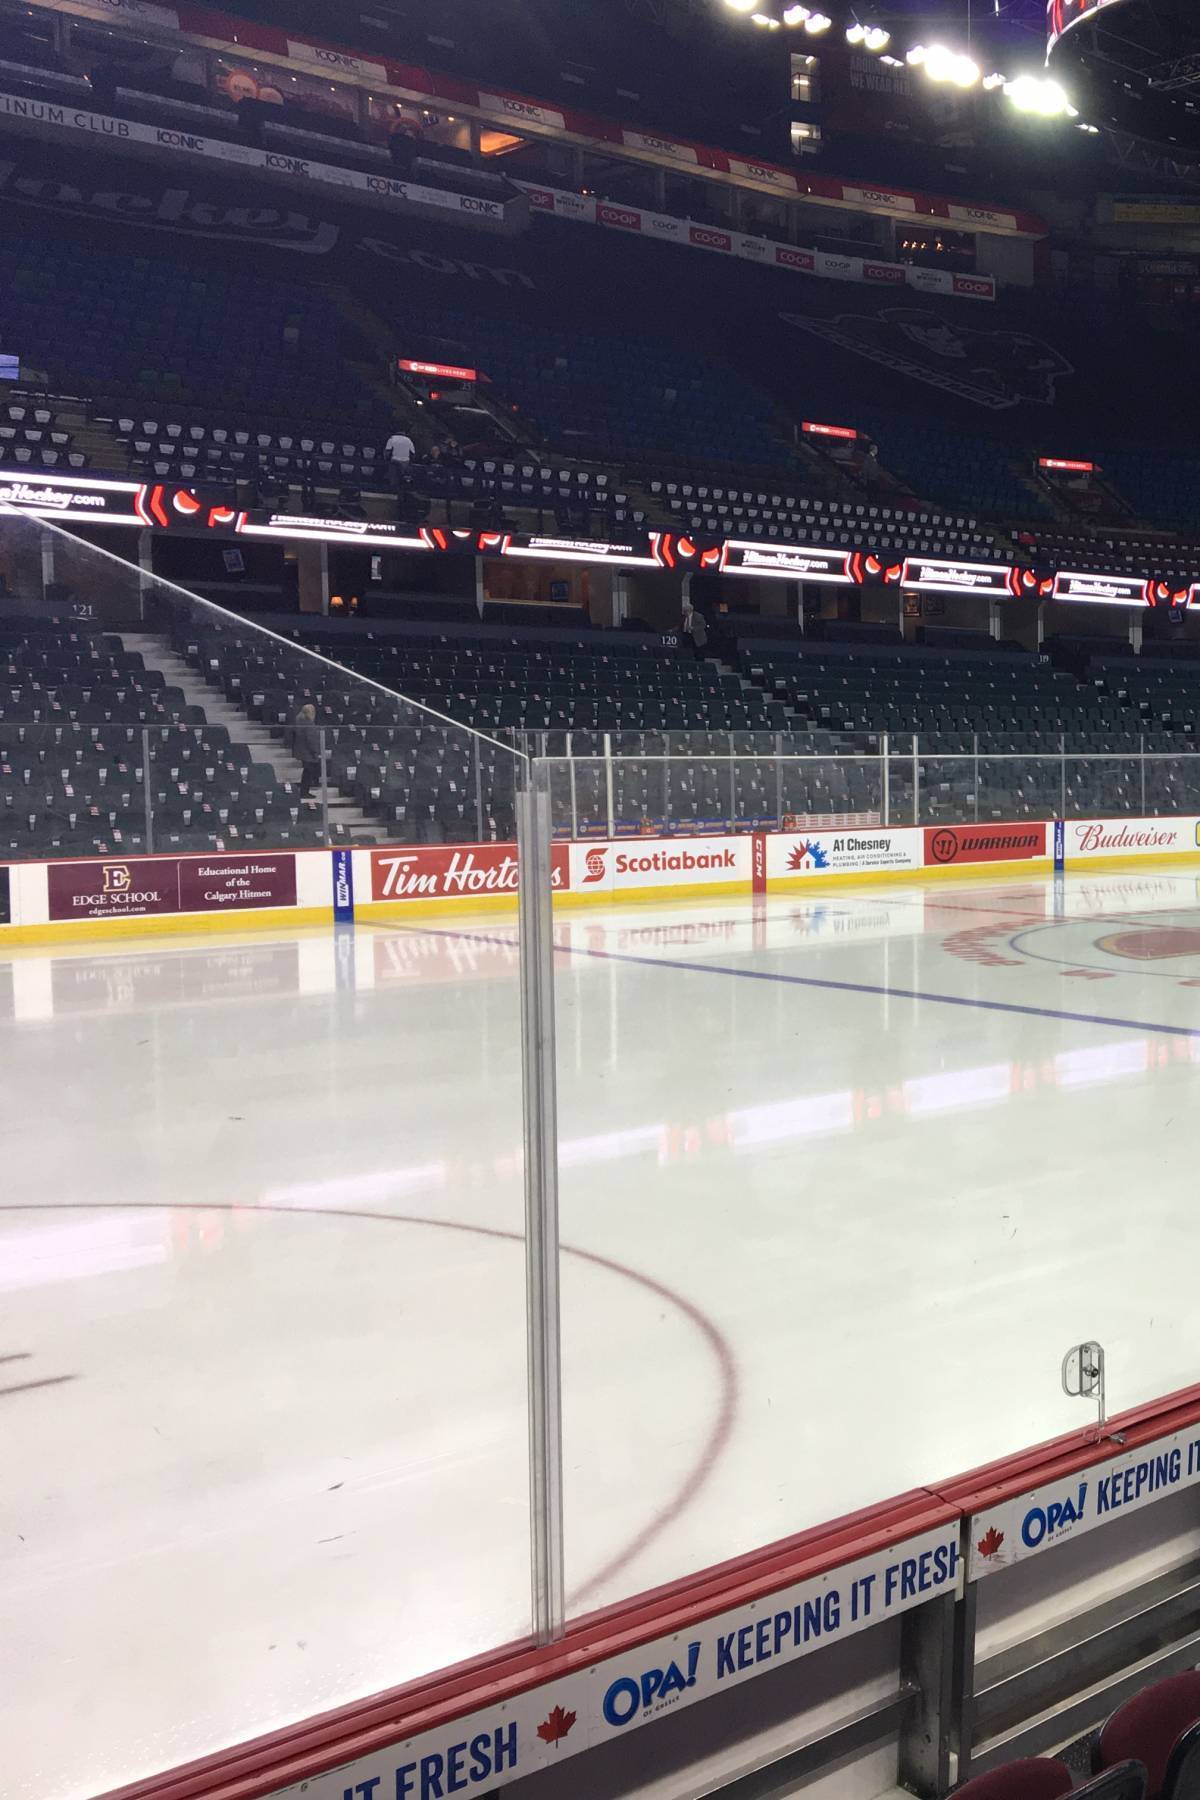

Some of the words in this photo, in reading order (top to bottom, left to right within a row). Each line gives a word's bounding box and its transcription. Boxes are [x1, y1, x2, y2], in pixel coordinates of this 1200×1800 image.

[74, 113, 131, 138] CLUB
[156, 130, 204, 151] ICONIC
[265, 154, 310, 175] ICONIC
[366, 176, 408, 197] ICONIC
[460, 197, 499, 217] ICONIC
[73, 604, 93, 616] 121
[661, 635, 678, 645] 120
[833, 840, 844, 852] A1
[847, 837, 891, 852] Chesney
[960, 835, 1037, 851] WARRIOR
[1075, 824, 1177, 851] Budweiser
[198, 865, 249, 878] Educational
[250, 863, 276, 875] Home
[616, 849, 737, 875] Scotiabank
[226, 877, 235, 887] of
[236, 877, 250, 887] the
[378, 855, 436, 897] Tim
[443, 852, 562, 893] Hortos
[72, 892, 108, 907] EDGE
[111, 891, 161, 905] SCHOOL
[204, 889, 238, 902] Calgary
[239, 888, 272, 900] Hitmen
[89, 905, 146, 917] edgeschool.com
[1021, 1482, 1088, 1548] OPA!
[1097, 1448, 1181, 1515] KEEPING
[602, 1640, 702, 1727] OPA!
[717, 1589, 841, 1680] KEEPING
[851, 1574, 876, 1622] IT
[394, 1721, 518, 1800] FRESH
